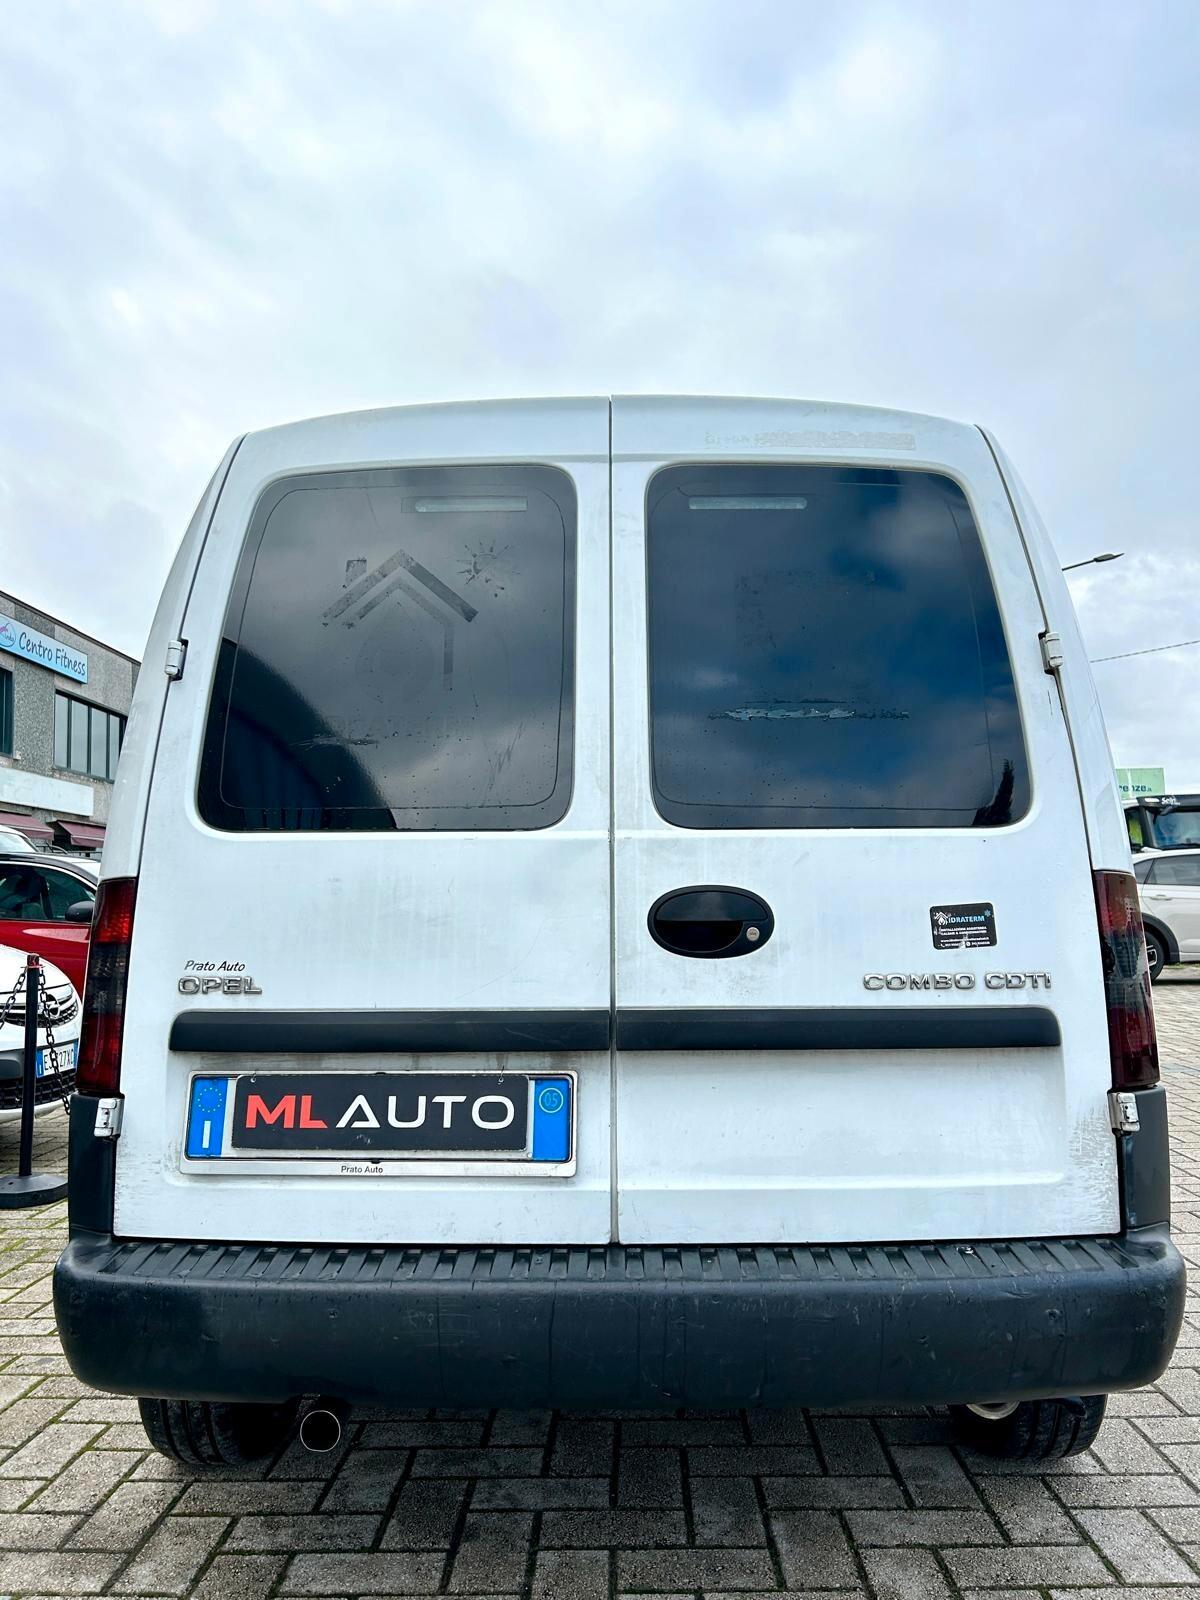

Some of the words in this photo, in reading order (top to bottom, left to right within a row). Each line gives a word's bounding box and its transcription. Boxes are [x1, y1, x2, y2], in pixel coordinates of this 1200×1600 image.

[19, 632, 53, 662] Centro
[55, 648, 86, 676] Fitness
[184, 960, 216, 972] Prato
[217, 961, 246, 972] Auto
[178, 976, 263, 995] OPEL
[863, 973, 976, 991] COMBO
[984, 972, 1052, 989] CDTI
[544, 1092, 558, 1108] 05
[245, 1095, 328, 1129] ML
[335, 1094, 515, 1130] AUTO
[341, 1165, 363, 1173] Prato
[364, 1165, 384, 1173] Auto
